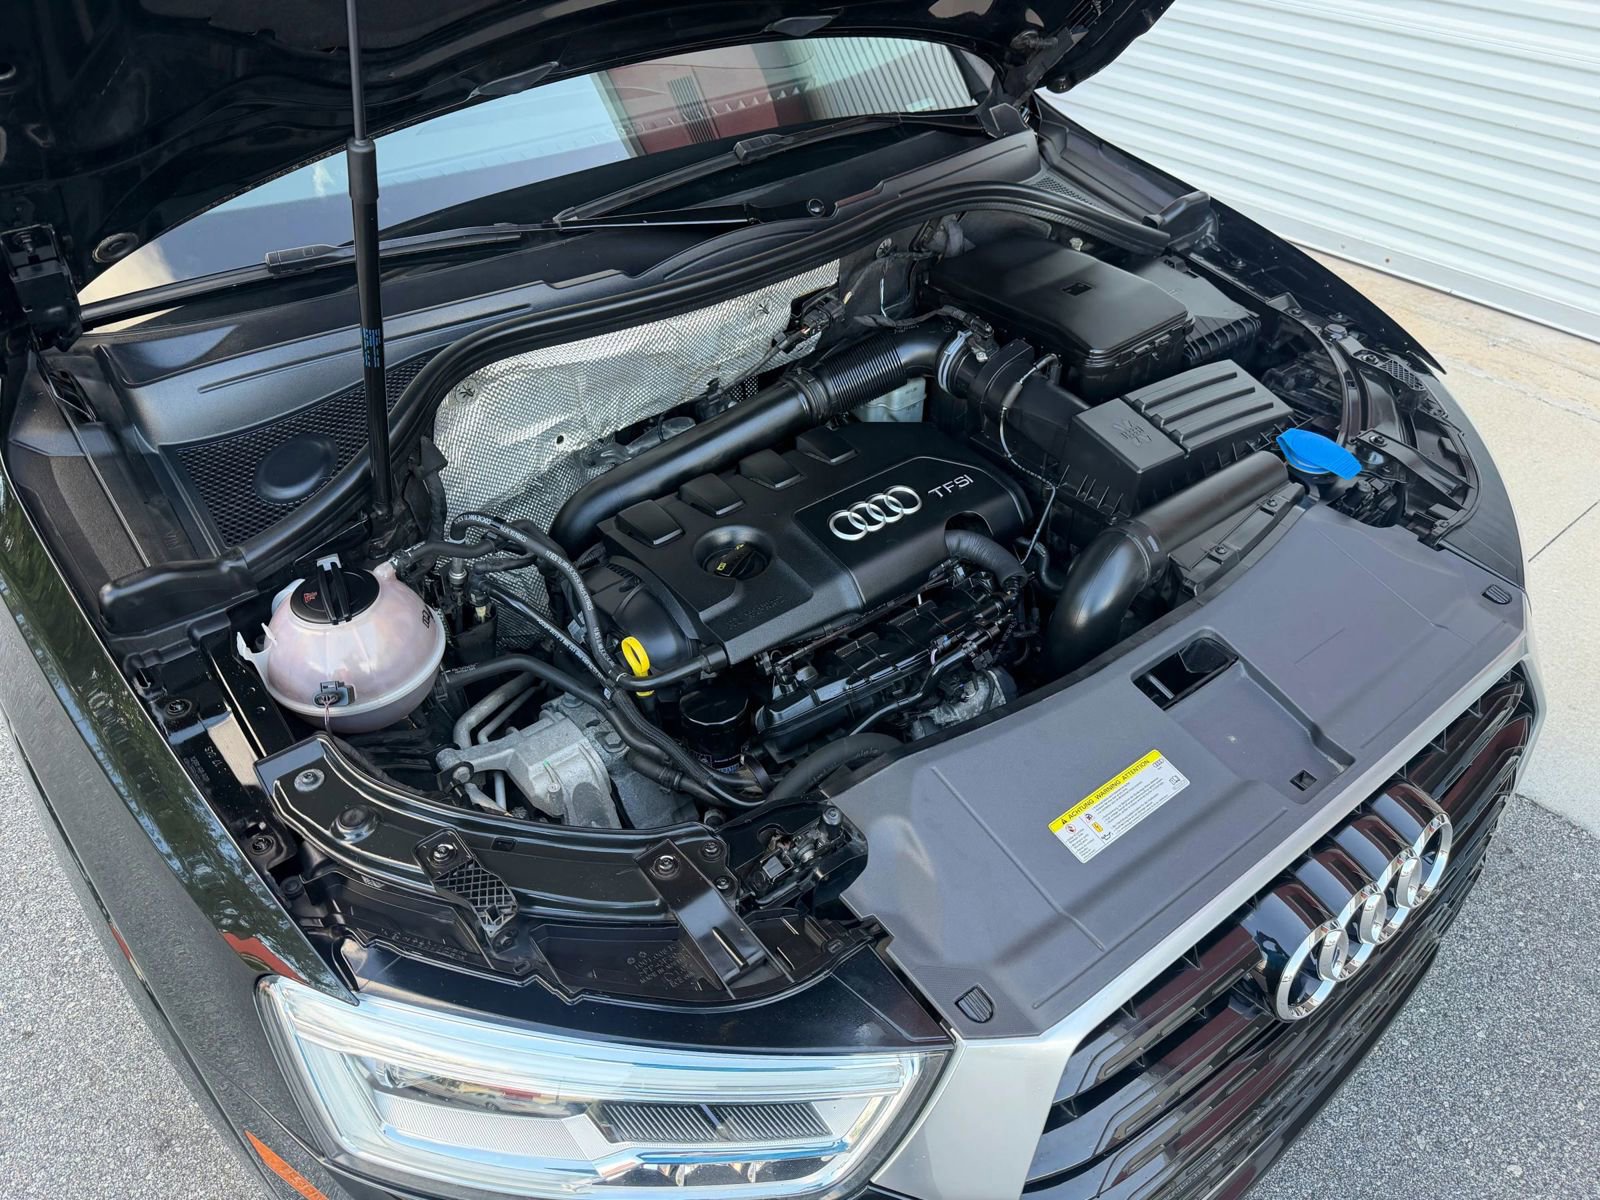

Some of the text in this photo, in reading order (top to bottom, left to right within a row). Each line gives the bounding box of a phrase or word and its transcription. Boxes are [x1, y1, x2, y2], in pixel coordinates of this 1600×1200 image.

[928, 474, 974, 498] TFSI
[1068, 799, 1095, 820] ACHTUNG
[1095, 780, 1121, 800] WARNING
[1122, 759, 1150, 781] ATTENTION
